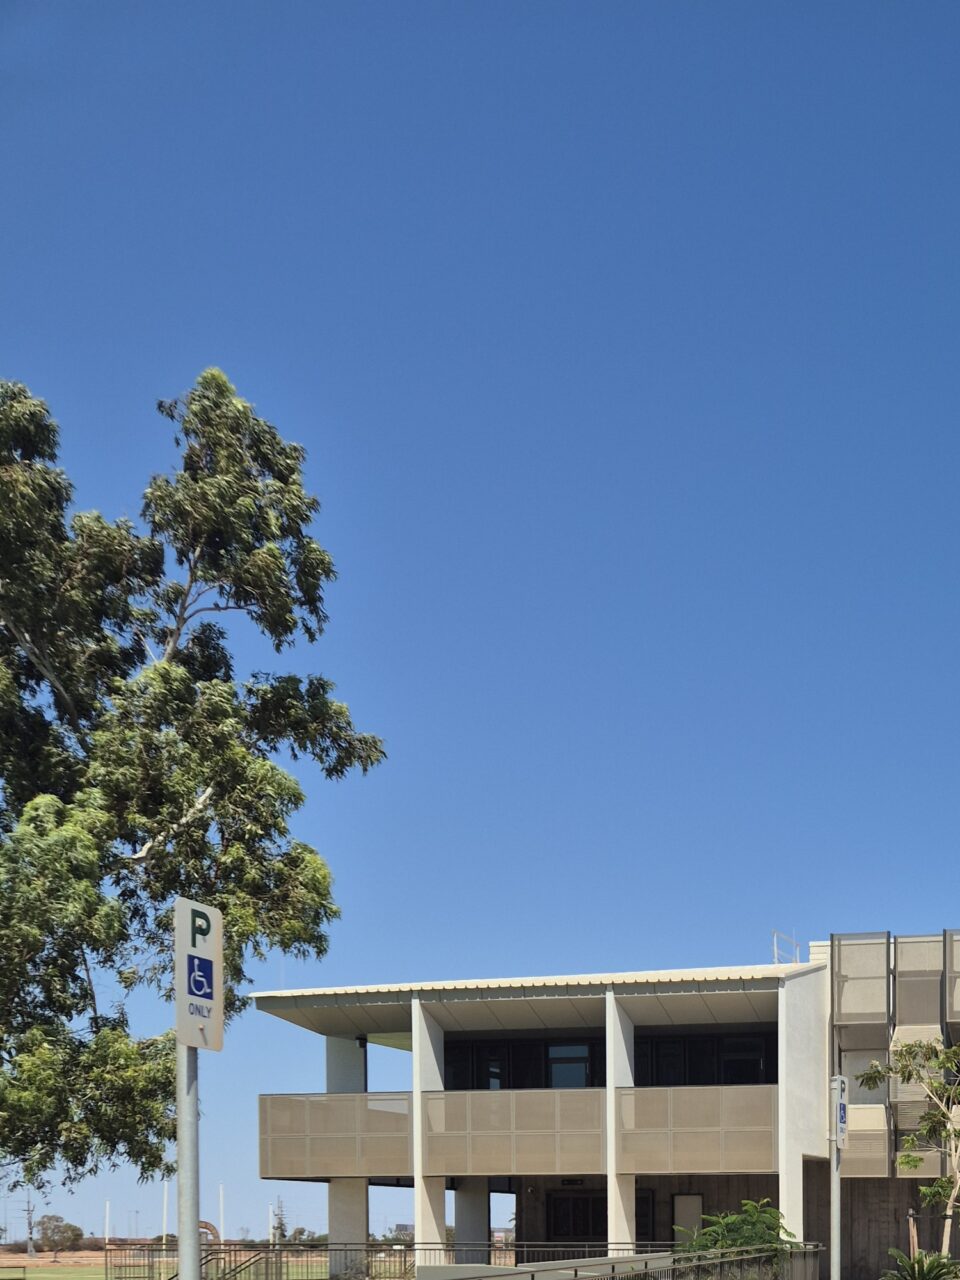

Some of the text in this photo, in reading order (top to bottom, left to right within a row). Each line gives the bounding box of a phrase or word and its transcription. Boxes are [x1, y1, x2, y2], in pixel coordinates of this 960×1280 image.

[191, 908, 211, 948] P
[188, 1002, 212, 1019] ONLY
[841, 1079, 846, 1100] P
